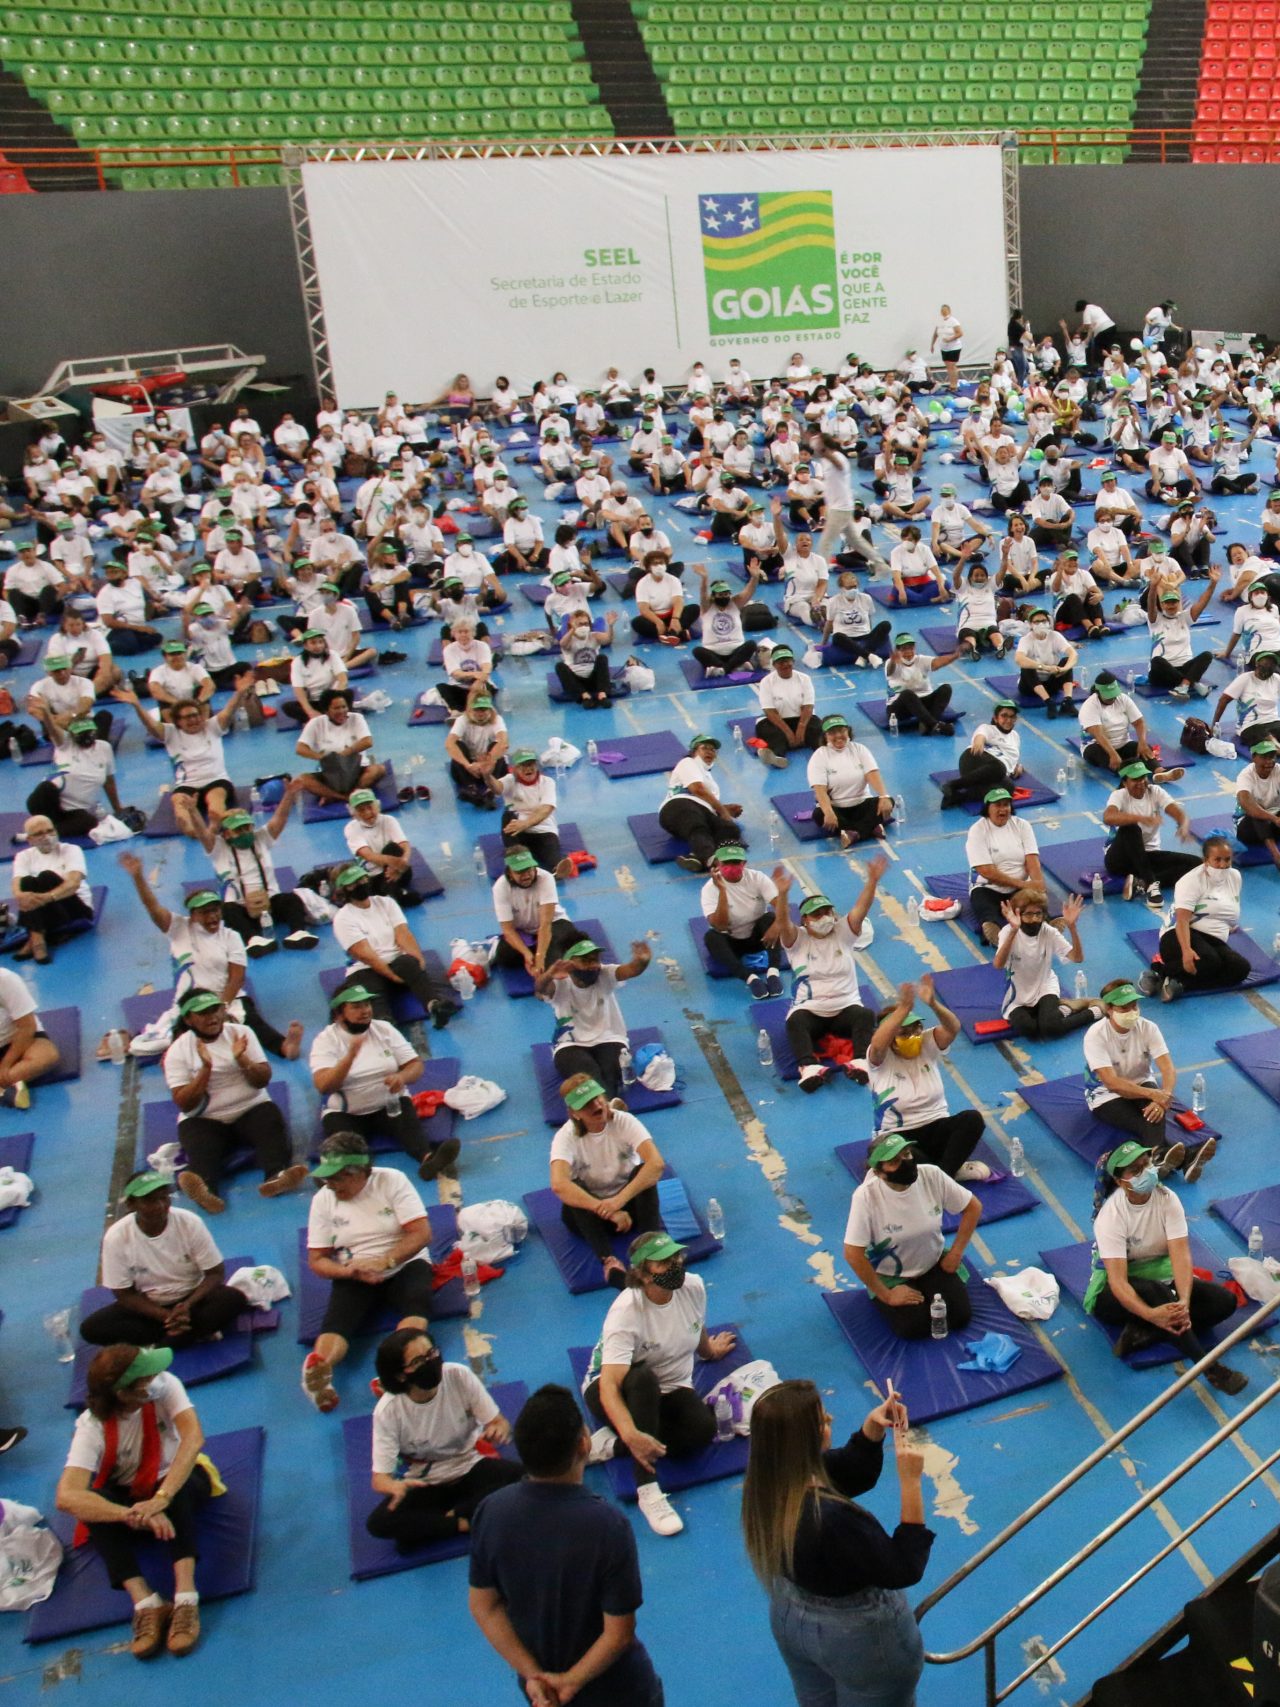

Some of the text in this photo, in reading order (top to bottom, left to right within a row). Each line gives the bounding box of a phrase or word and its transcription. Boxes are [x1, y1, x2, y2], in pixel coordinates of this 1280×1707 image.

[583, 248, 641, 267] SEEL
[840, 250, 882, 264] É POR
[841, 265, 880, 279] VOCÊ
[490, 272, 641, 291] Secretaria de Estado
[842, 282, 885, 295] QUE A
[509, 291, 643, 309] de Esporte e Lazer
[843, 297, 887, 309] GENTE
[844, 313, 870, 324] FAZ
[710, 332, 841, 347] GOVERNO DO ESTADO
